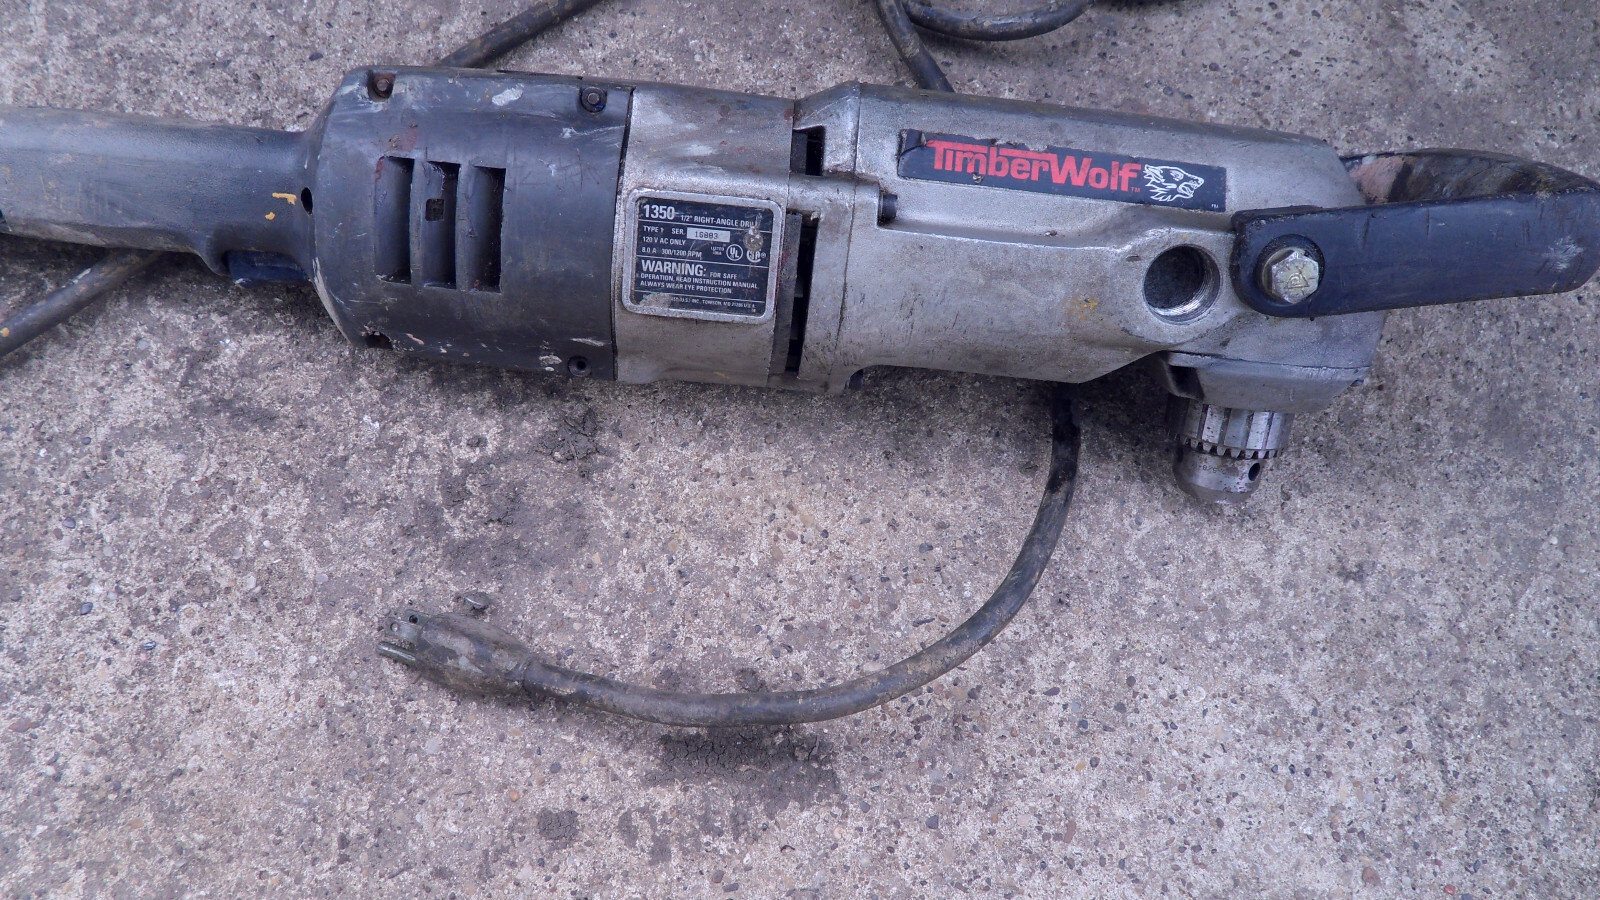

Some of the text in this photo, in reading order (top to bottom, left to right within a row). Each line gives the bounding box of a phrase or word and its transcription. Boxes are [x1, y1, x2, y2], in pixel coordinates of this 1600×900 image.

[926, 139, 1142, 192] TimberWolf
[643, 204, 676, 220] 1350
[693, 216, 739, 227] RIGHT-ANGLE
[643, 225, 659, 233] TYPE
[669, 238, 686, 246] ONLY
[661, 248, 687, 256] 300/1200
[687, 250, 702, 258] RPM
[641, 259, 707, 277] WARNING:
[722, 272, 737, 280] SAFE
[640, 280, 665, 289] ALWAYS
[665, 282, 684, 290] WEAR
[675, 275, 692, 283] READ
[692, 277, 732, 287] INSTRUCTION
